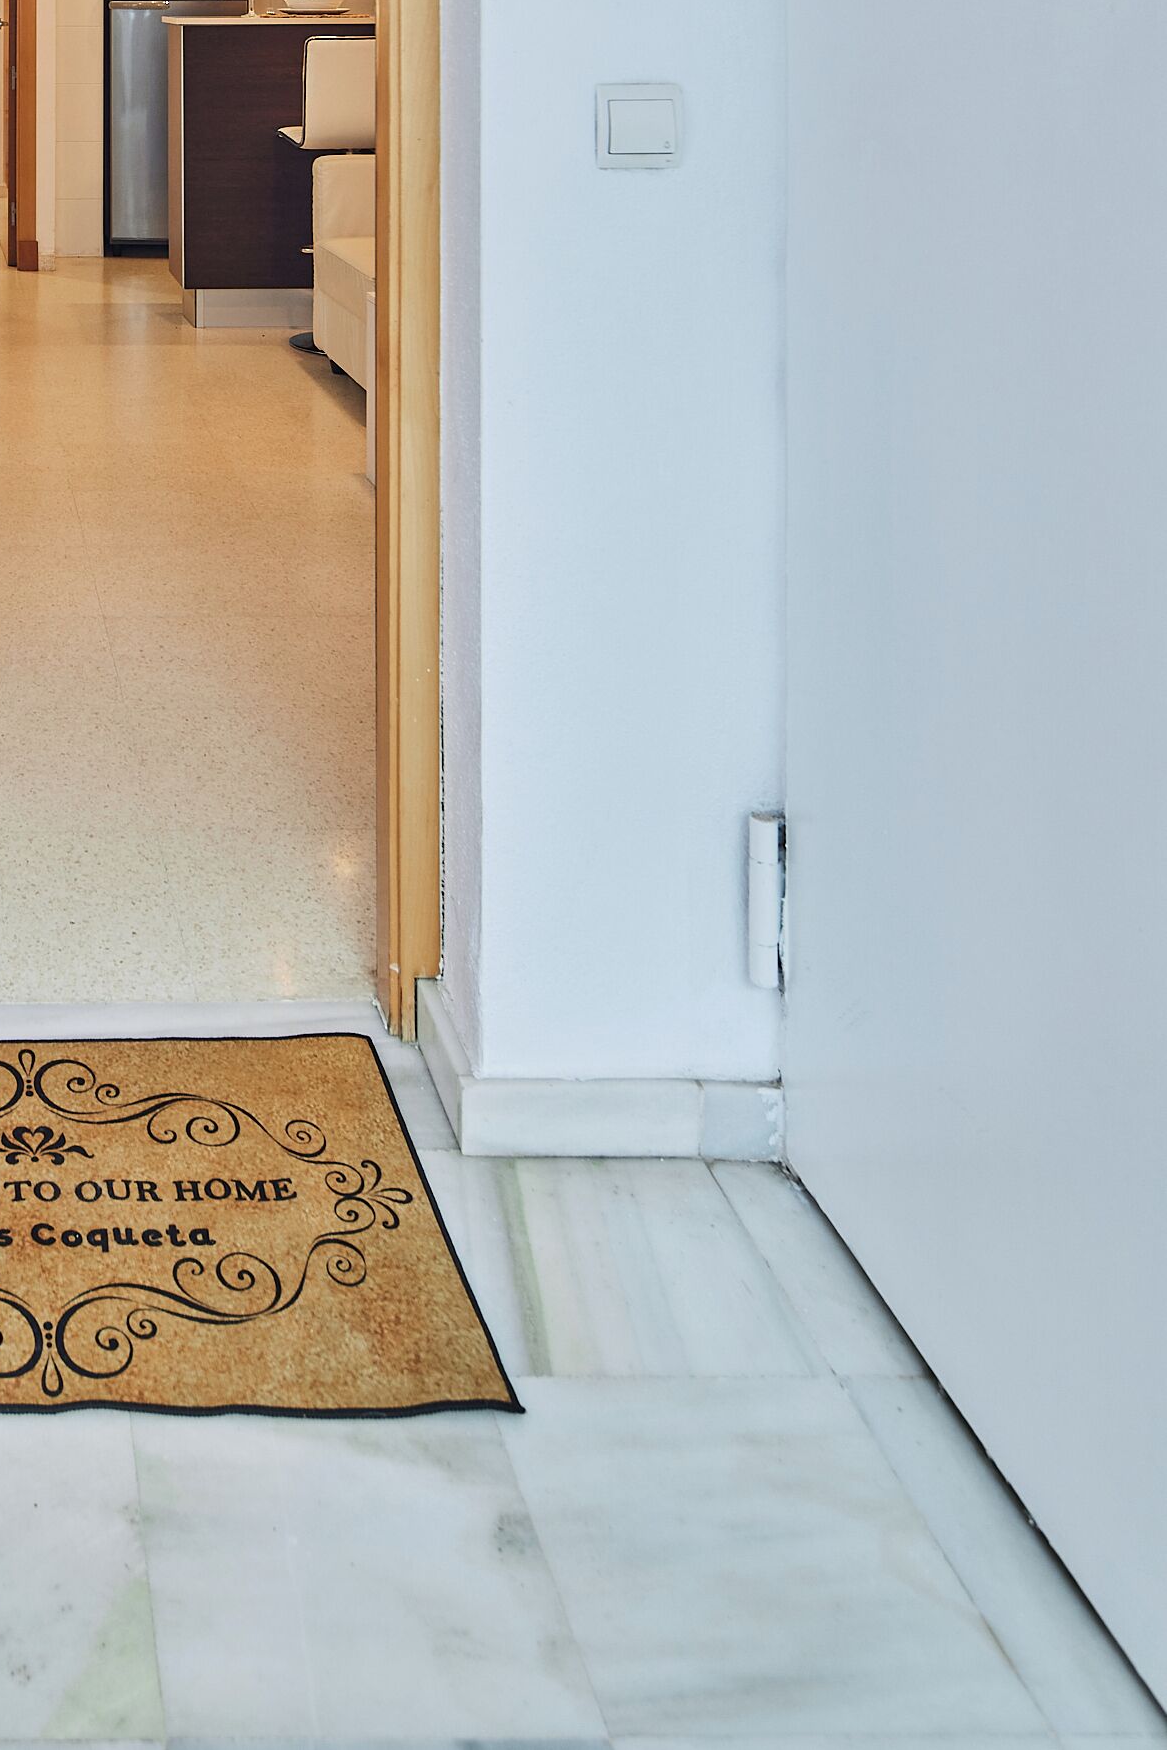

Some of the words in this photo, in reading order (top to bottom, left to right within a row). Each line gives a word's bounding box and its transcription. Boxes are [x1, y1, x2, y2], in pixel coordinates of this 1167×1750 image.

[3, 1180, 62, 1203] TO
[74, 1179, 163, 1203] OUR
[172, 1177, 298, 1202] HOME
[30, 1222, 217, 1253] Coqueta
